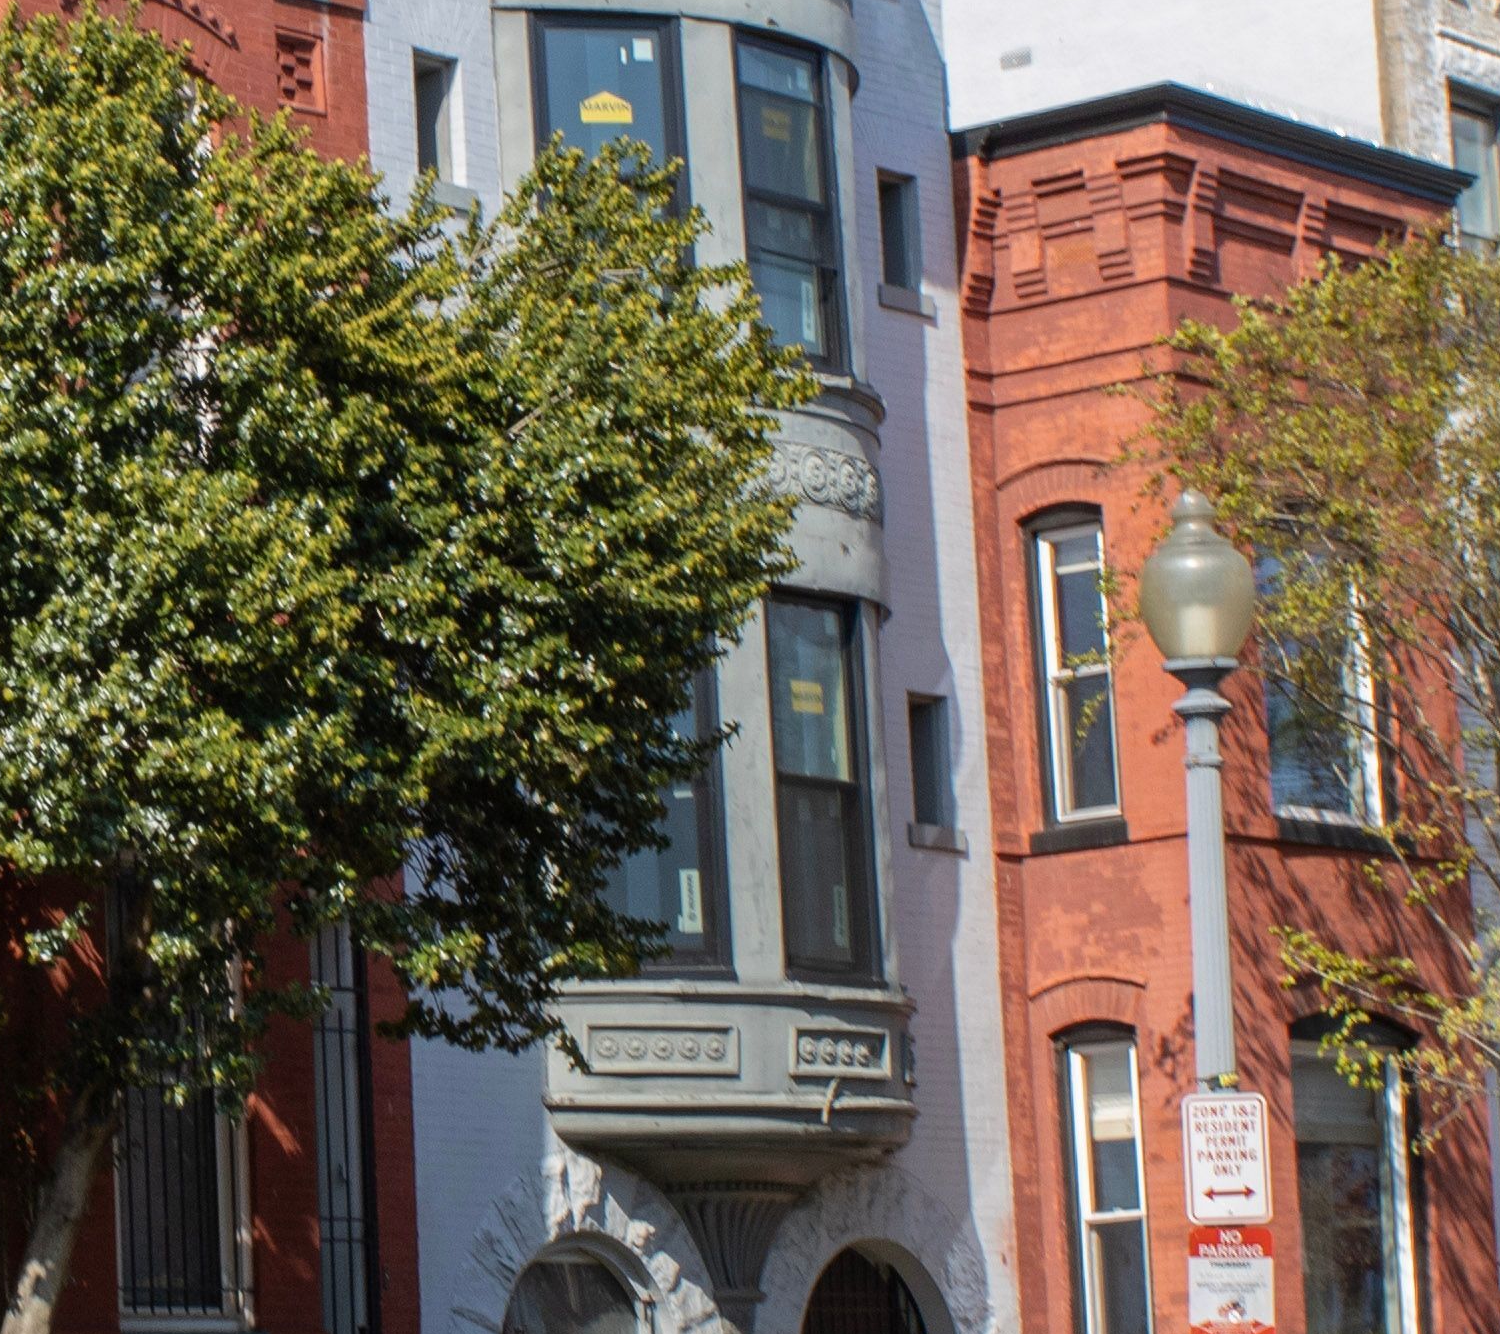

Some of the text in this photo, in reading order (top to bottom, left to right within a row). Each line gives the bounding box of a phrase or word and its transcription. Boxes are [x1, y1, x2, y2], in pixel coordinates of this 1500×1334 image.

[580, 100, 630, 112] MARVIN
[1193, 1104, 1225, 1118] ZONE
[1194, 1119, 1256, 1134] RESIDENT
[1206, 1135, 1247, 1148] PERMIT
[1197, 1149, 1257, 1163] PARKING
[1213, 1164, 1241, 1177] ONLY
[1219, 1228, 1243, 1244] NO
[1198, 1242, 1264, 1258] PARKING
